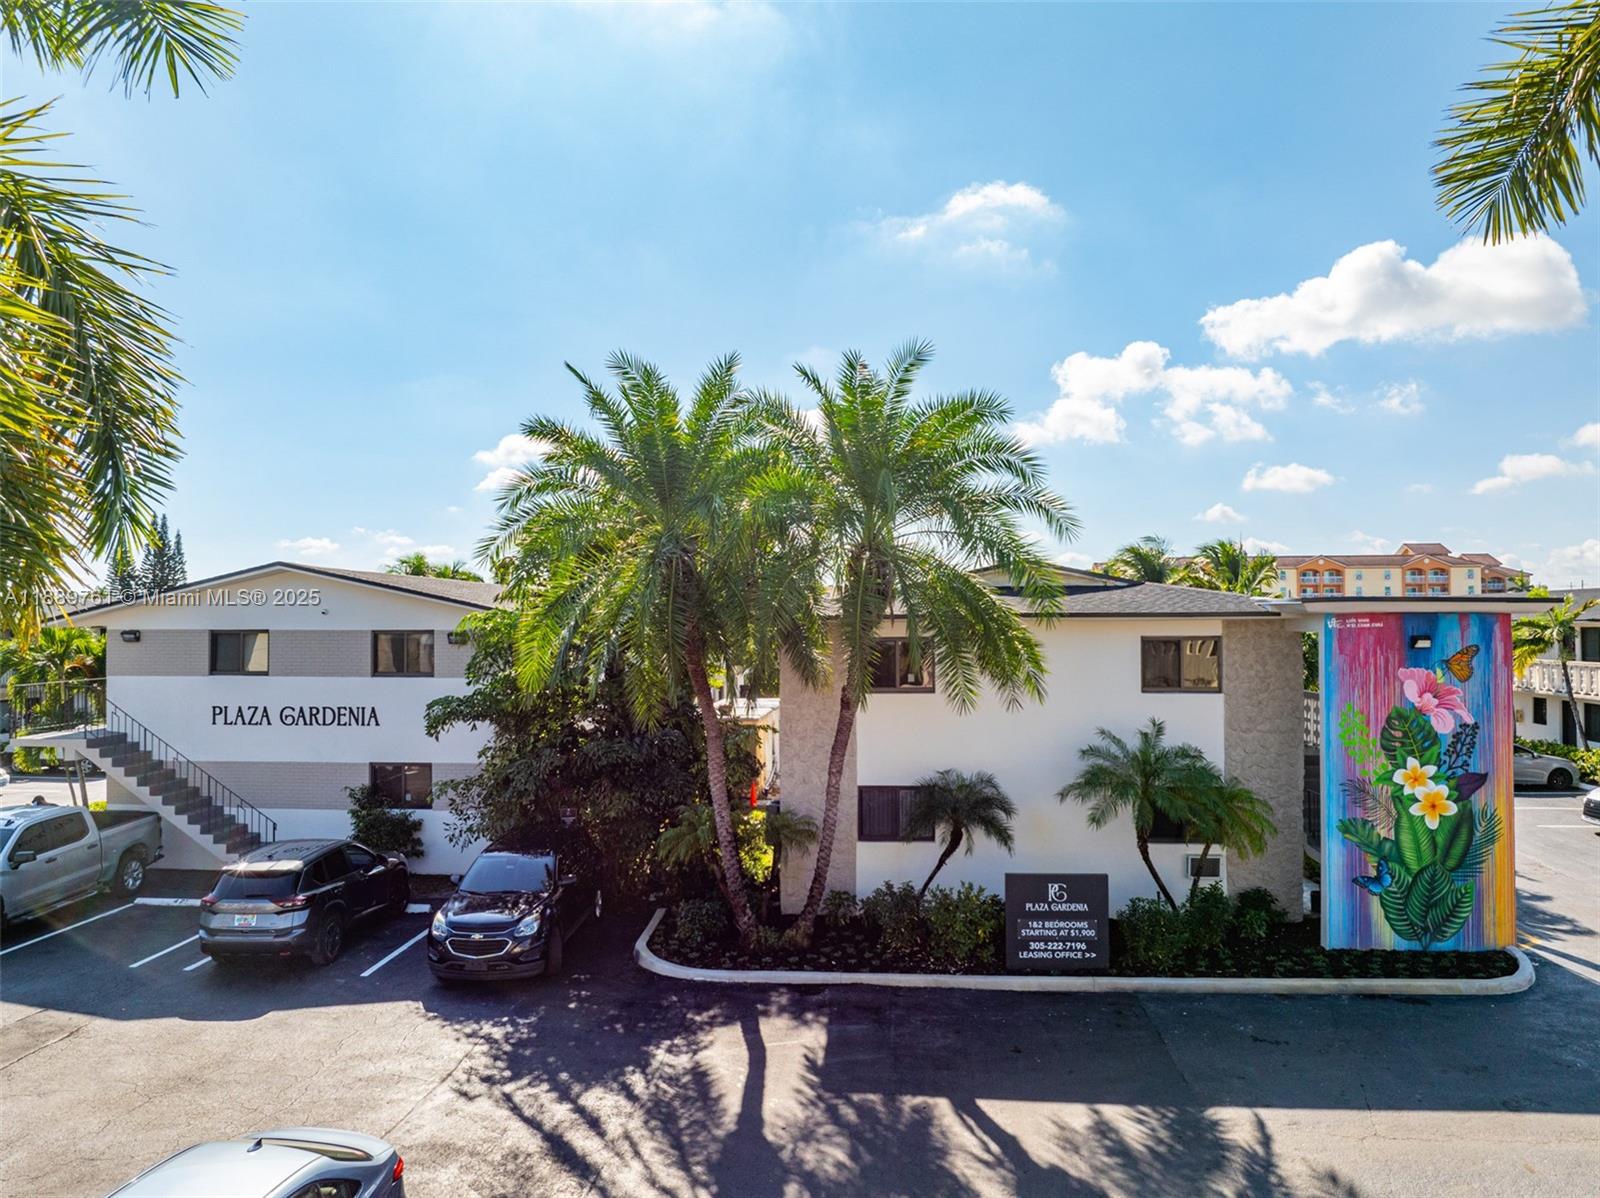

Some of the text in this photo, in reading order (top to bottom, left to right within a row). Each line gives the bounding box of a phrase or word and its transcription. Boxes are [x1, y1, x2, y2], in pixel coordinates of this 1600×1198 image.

[211, 705, 380, 727] PLAZA GARDENIA
[1025, 903, 1088, 911] PLAZA GARDENIA
[1044, 921, 1089, 929] BEDROOMS
[1029, 942, 1087, 950] 305-222-7196
[1019, 951, 1053, 959] LEASING
[1054, 951, 1083, 959] OFFICE
